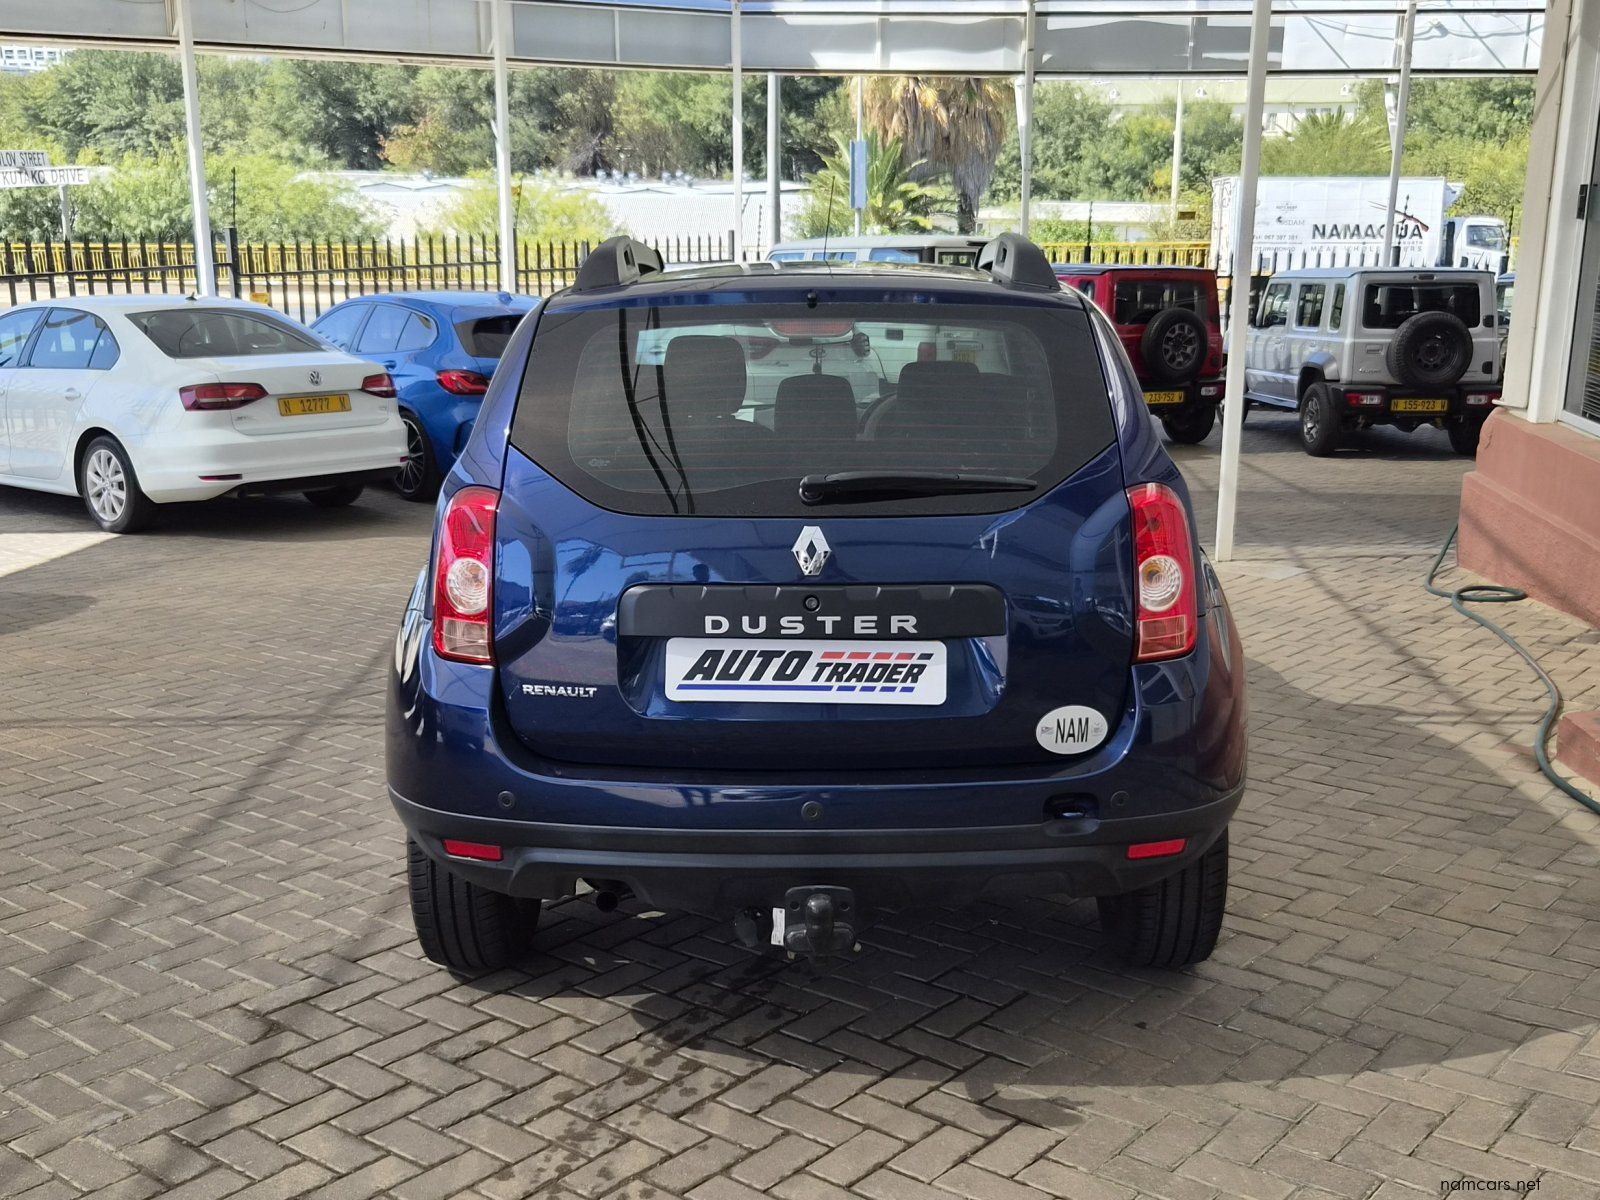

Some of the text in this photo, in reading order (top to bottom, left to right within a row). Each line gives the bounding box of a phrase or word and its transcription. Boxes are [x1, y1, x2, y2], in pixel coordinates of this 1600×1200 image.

[20, 152, 46, 166] STREET
[51, 169, 84, 183] DRIVE
[300, 397, 330, 413] 12777
[1393, 400, 1447, 410] N 155-923 W
[704, 614, 919, 635] DUSTER
[681, 649, 928, 684] AUTO TRADER
[522, 684, 598, 698] RENAULT
[1055, 717, 1089, 744] NAM
